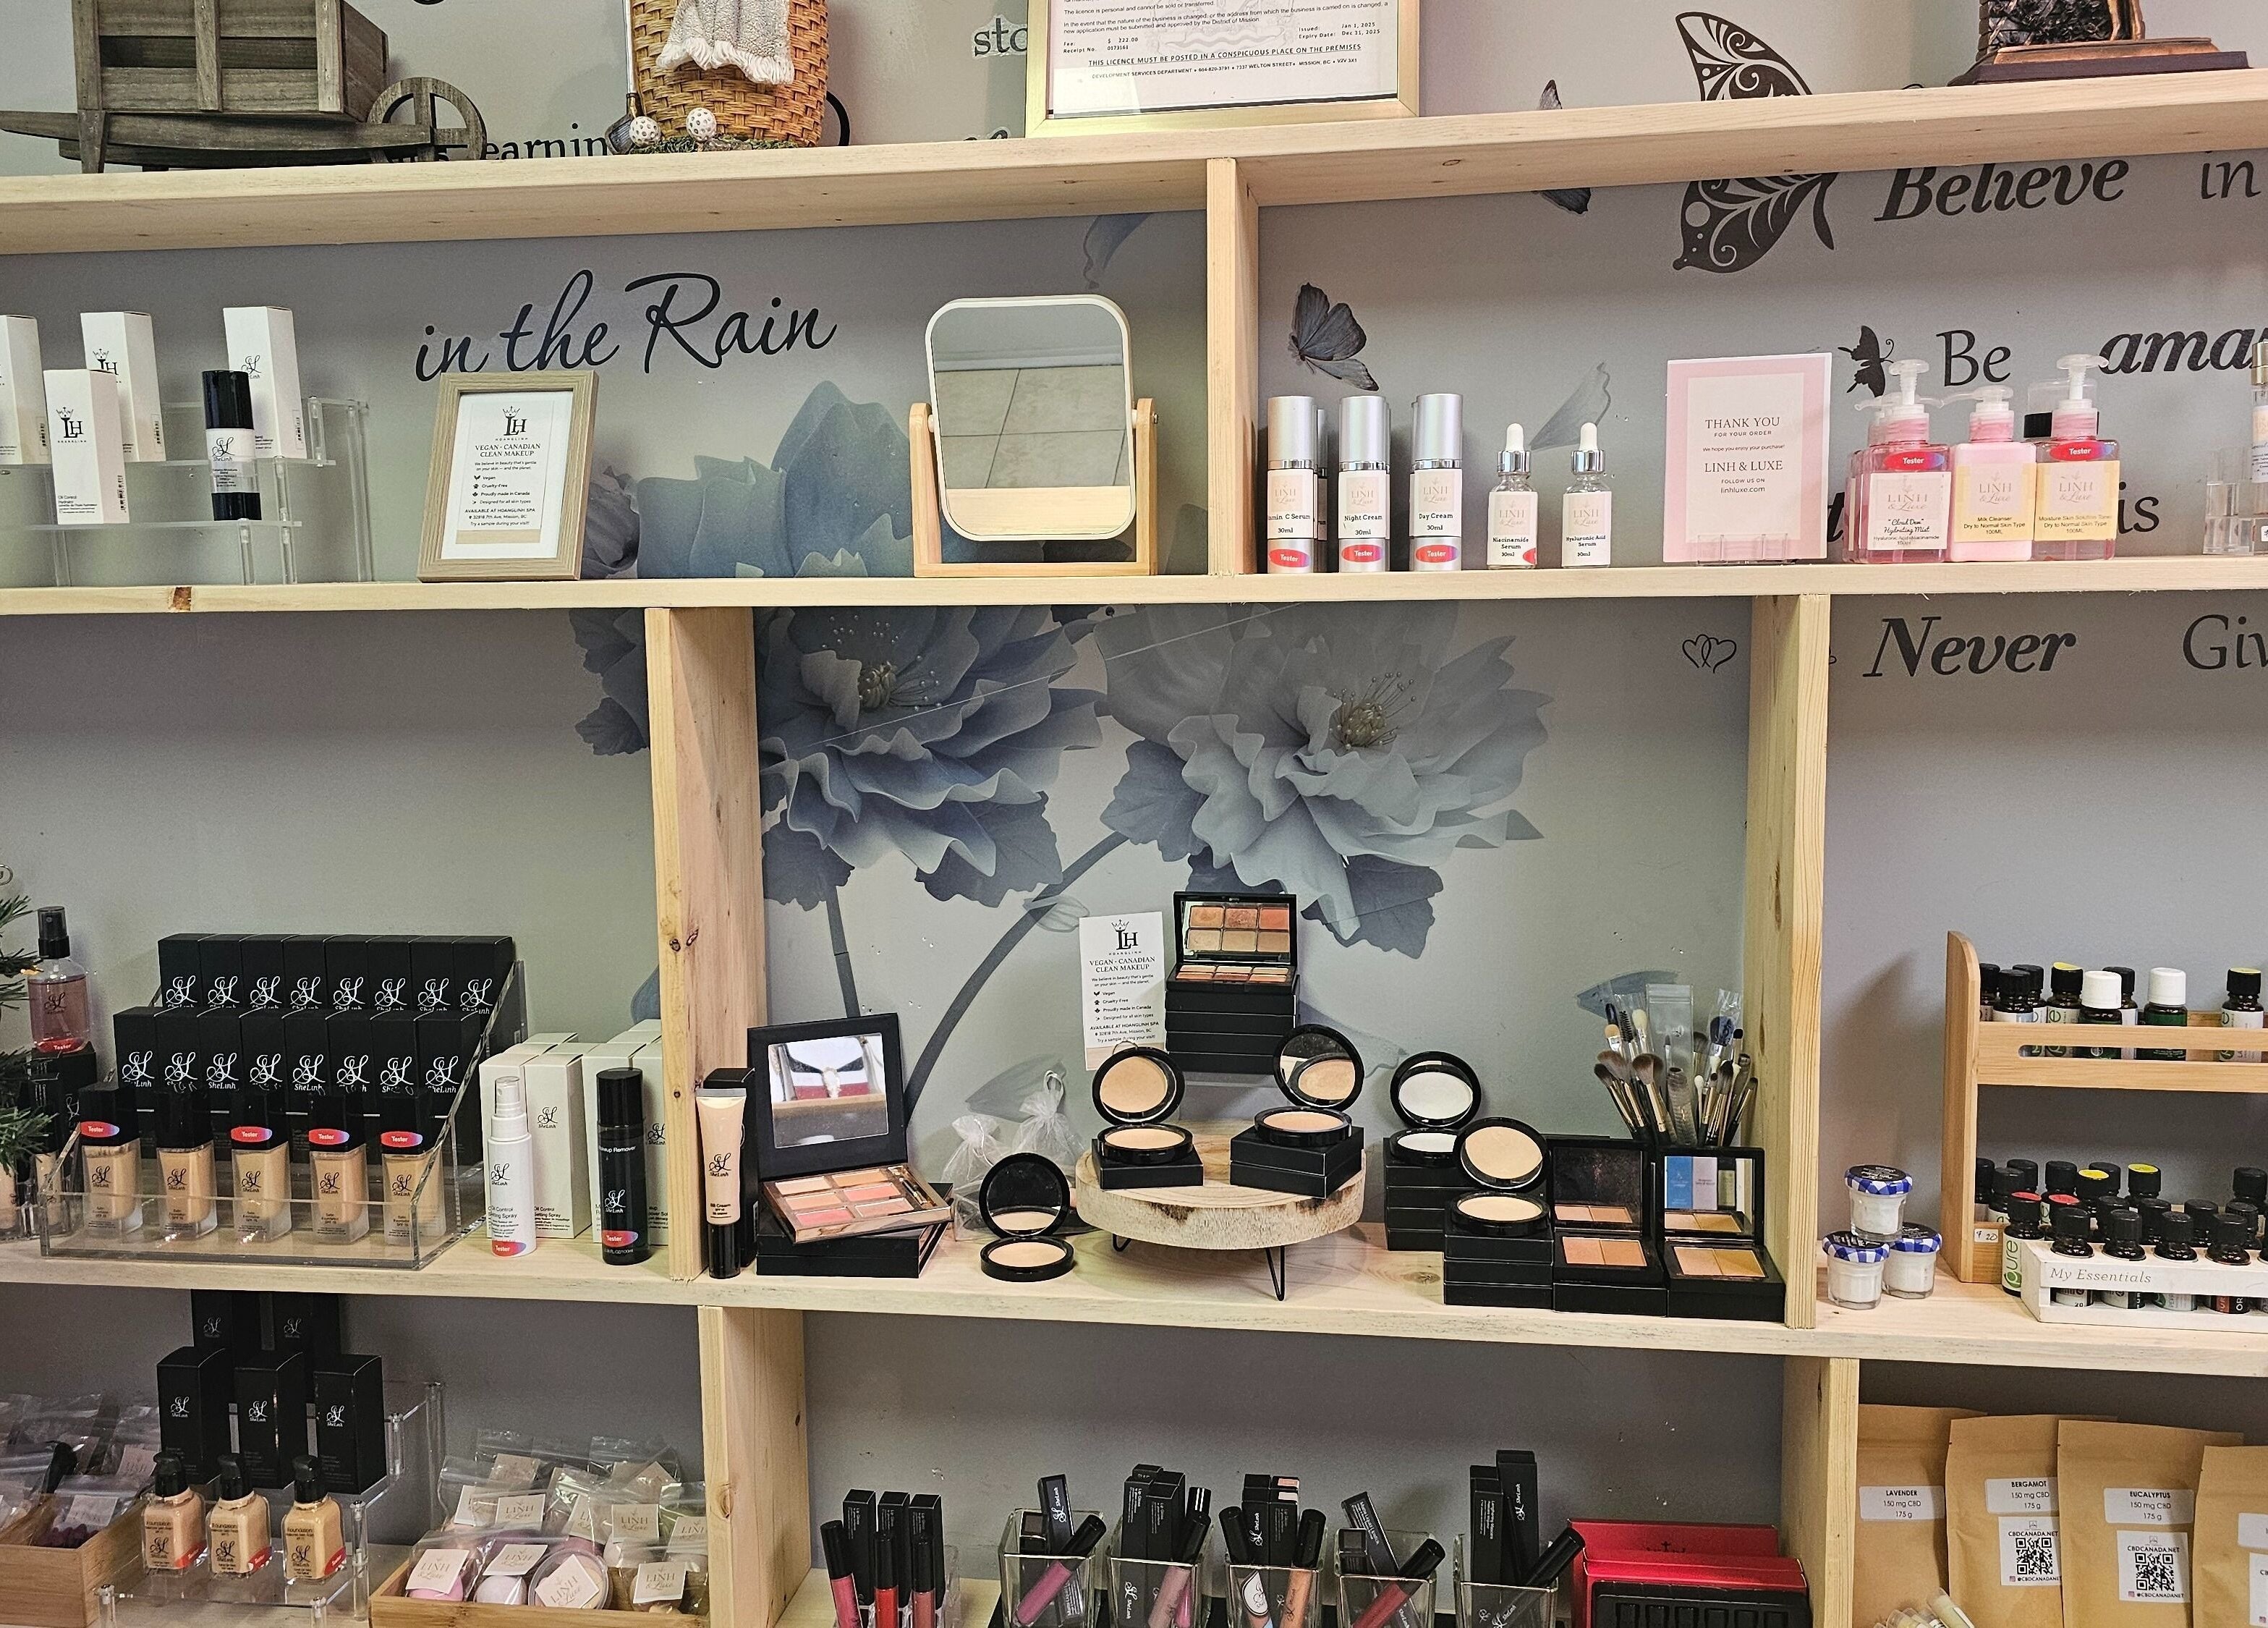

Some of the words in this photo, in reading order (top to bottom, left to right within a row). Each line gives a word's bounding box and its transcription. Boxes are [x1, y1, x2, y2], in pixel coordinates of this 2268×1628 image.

[1218, 49, 1269, 58] CONSPICUOUS
[1874, 158, 2129, 222] Believe
[2201, 150, 2259, 200] in
[416, 324, 490, 383] in
[500, 270, 620, 375] the
[625, 273, 837, 375] Rain
[1936, 329, 2012, 386] Be
[1705, 418, 1749, 428] THANK
[1754, 417, 1780, 426] YOU
[1705, 462, 1736, 472] LINH
[1738, 462, 1747, 471] &
[1751, 460, 1783, 470] LUXE
[2118, 481, 2159, 534] is
[1862, 616, 2076, 677] Never
[2050, 1268, 2071, 1281] My
[2076, 1270, 2152, 1284] Essentials
[621, 1517, 648, 1526] LINH
